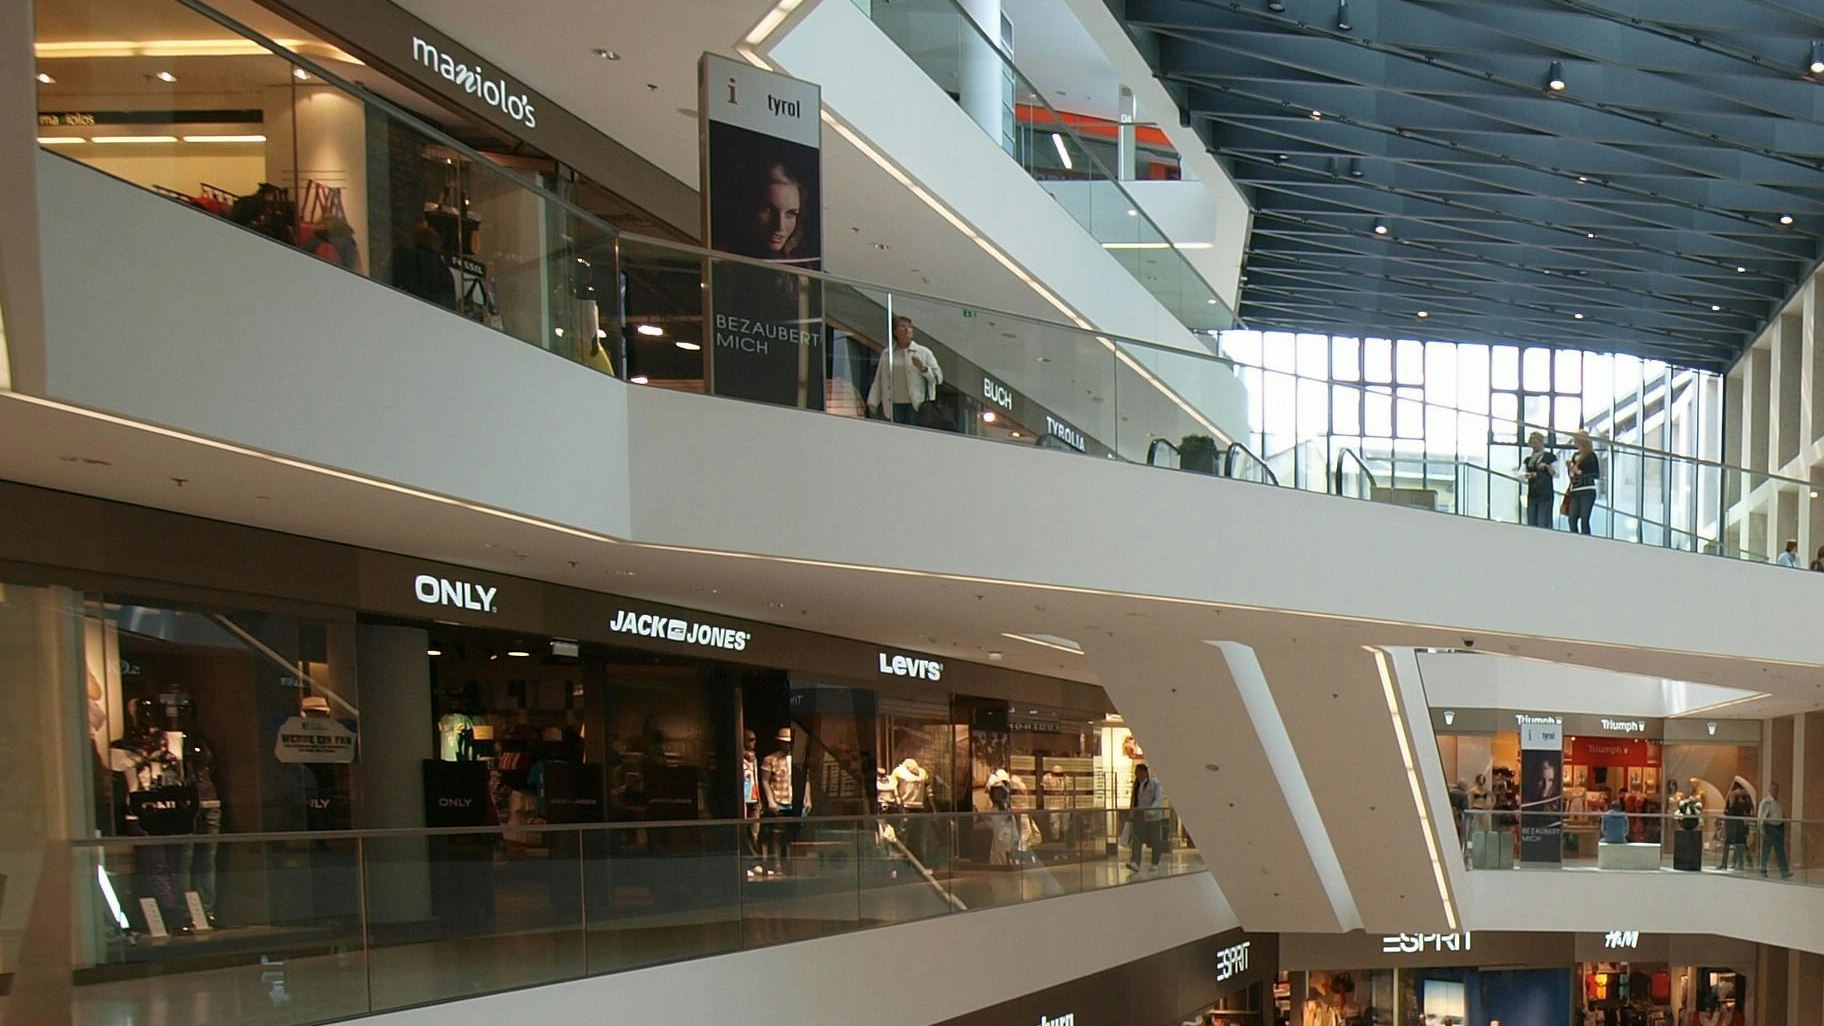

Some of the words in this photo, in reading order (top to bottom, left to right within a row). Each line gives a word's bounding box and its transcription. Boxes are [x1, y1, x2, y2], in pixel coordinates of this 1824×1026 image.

[413, 36, 536, 128] maniolo's
[768, 94, 800, 118] tyrol
[717, 314, 820, 347] BEZAUBERT
[717, 333, 768, 355] MICH
[984, 378, 1012, 411] BUCH
[1046, 416, 1086, 452] TYROLIA
[415, 575, 497, 612] ONLY
[610, 610, 668, 638] JACK
[686, 623, 747, 651] JONES
[1601, 719, 1638, 733] Triumph
[438, 798, 473, 808] ONLY
[1605, 930, 1639, 948] H&M
[1217, 941, 1250, 981] ESPRIT
